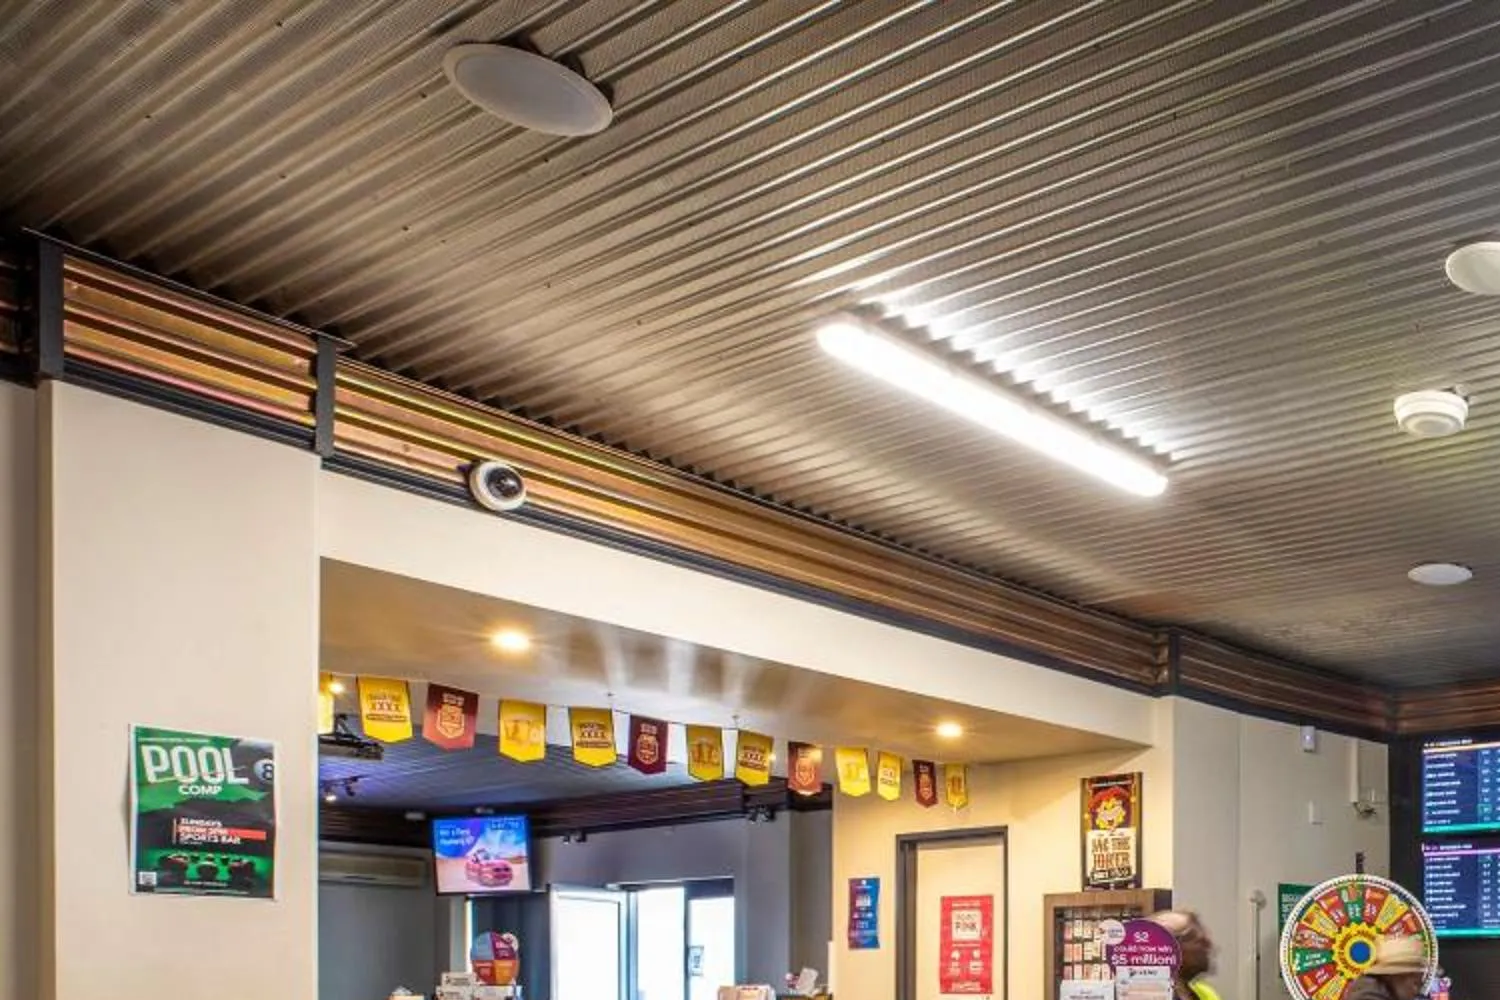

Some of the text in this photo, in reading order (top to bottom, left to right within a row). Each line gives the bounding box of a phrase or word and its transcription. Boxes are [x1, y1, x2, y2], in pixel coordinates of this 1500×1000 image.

[141, 744, 250, 785] POOL
[178, 784, 223, 796] COMP
[1111, 954, 1129, 965] $5
